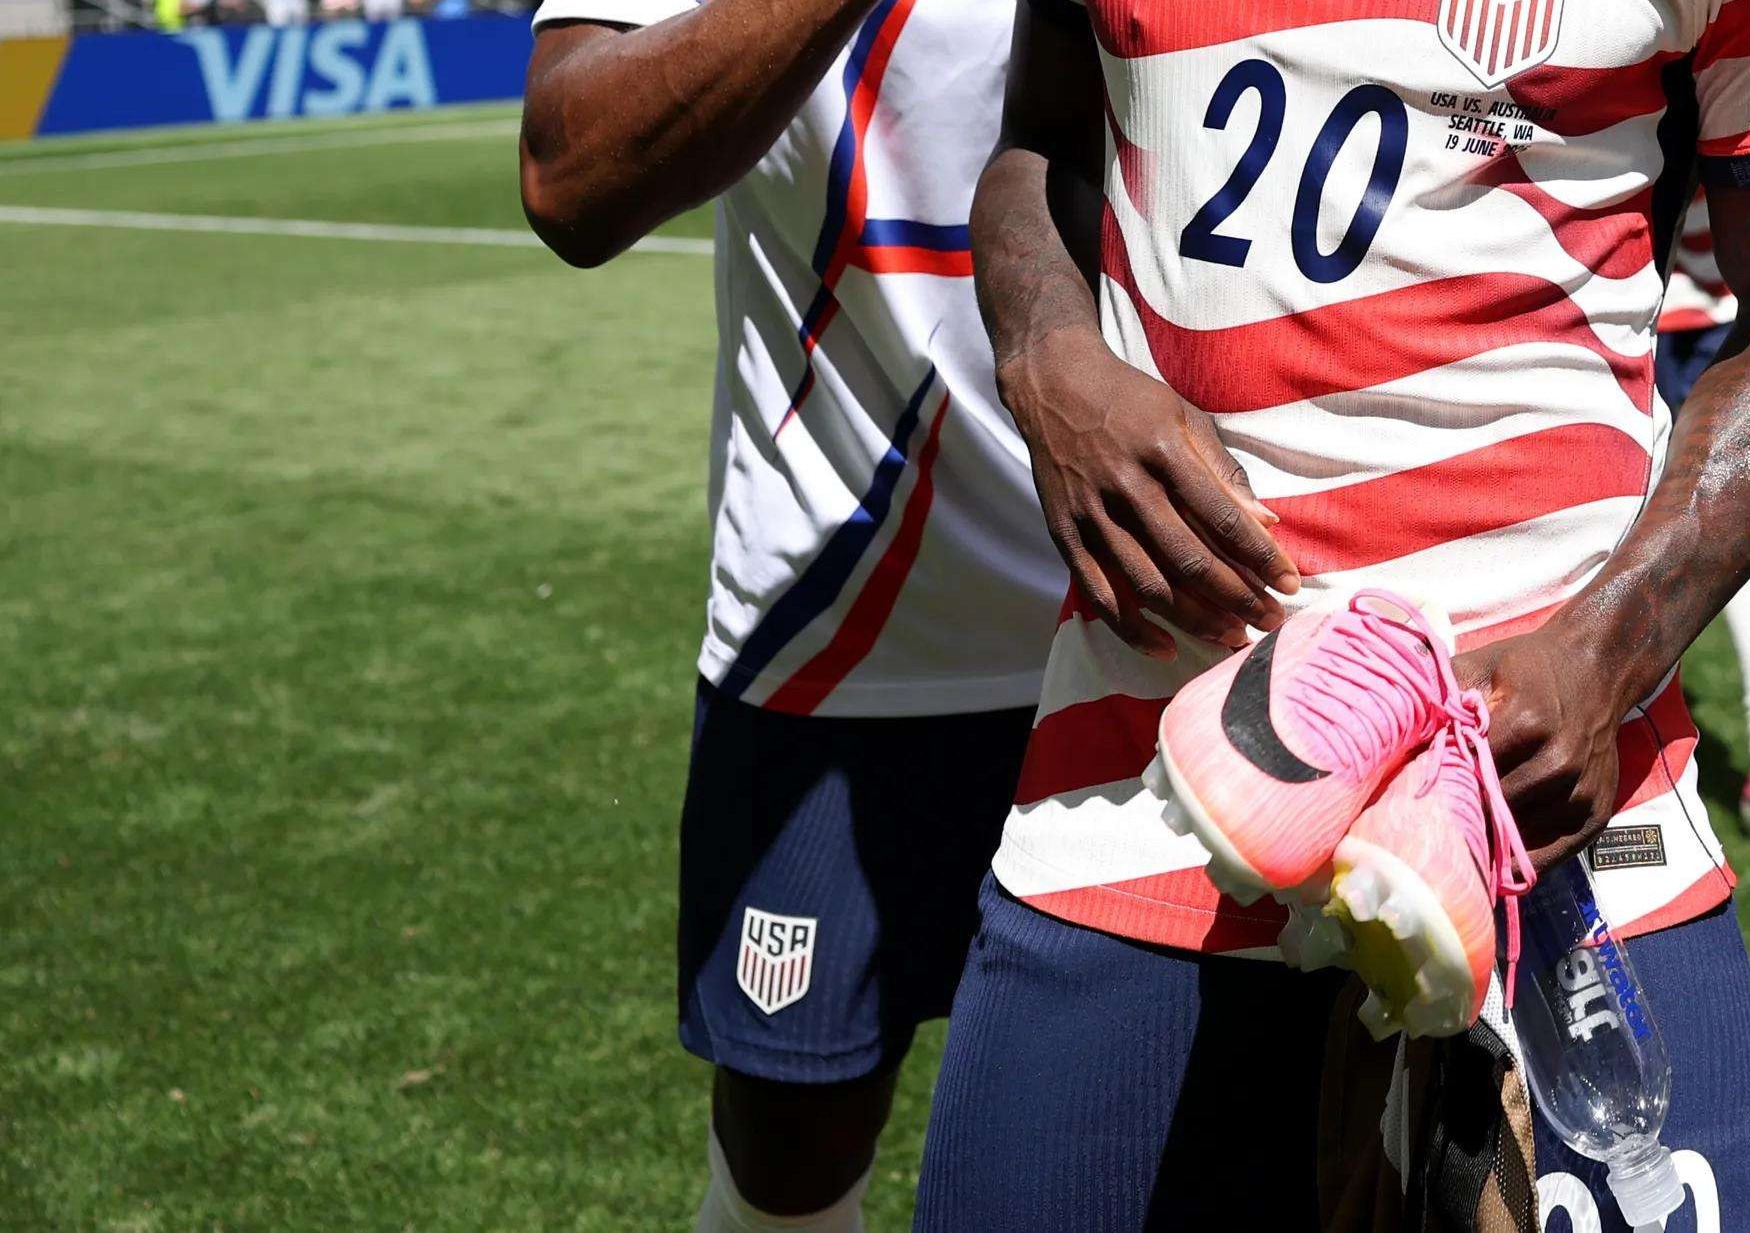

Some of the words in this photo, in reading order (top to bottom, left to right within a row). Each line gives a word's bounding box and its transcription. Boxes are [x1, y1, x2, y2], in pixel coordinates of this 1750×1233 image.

[172, 19, 437, 122] VISA
[1430, 91, 1458, 109] USA
[1462, 97, 1482, 114] VS.
[1448, 114, 1507, 140] SEATTLE,
[1513, 124, 1534, 141] WA
[1445, 134, 1459, 150] 19
[1462, 137, 1499, 157] JUNE
[1178, 58, 1409, 284] 20
[748, 915, 809, 957] USA
